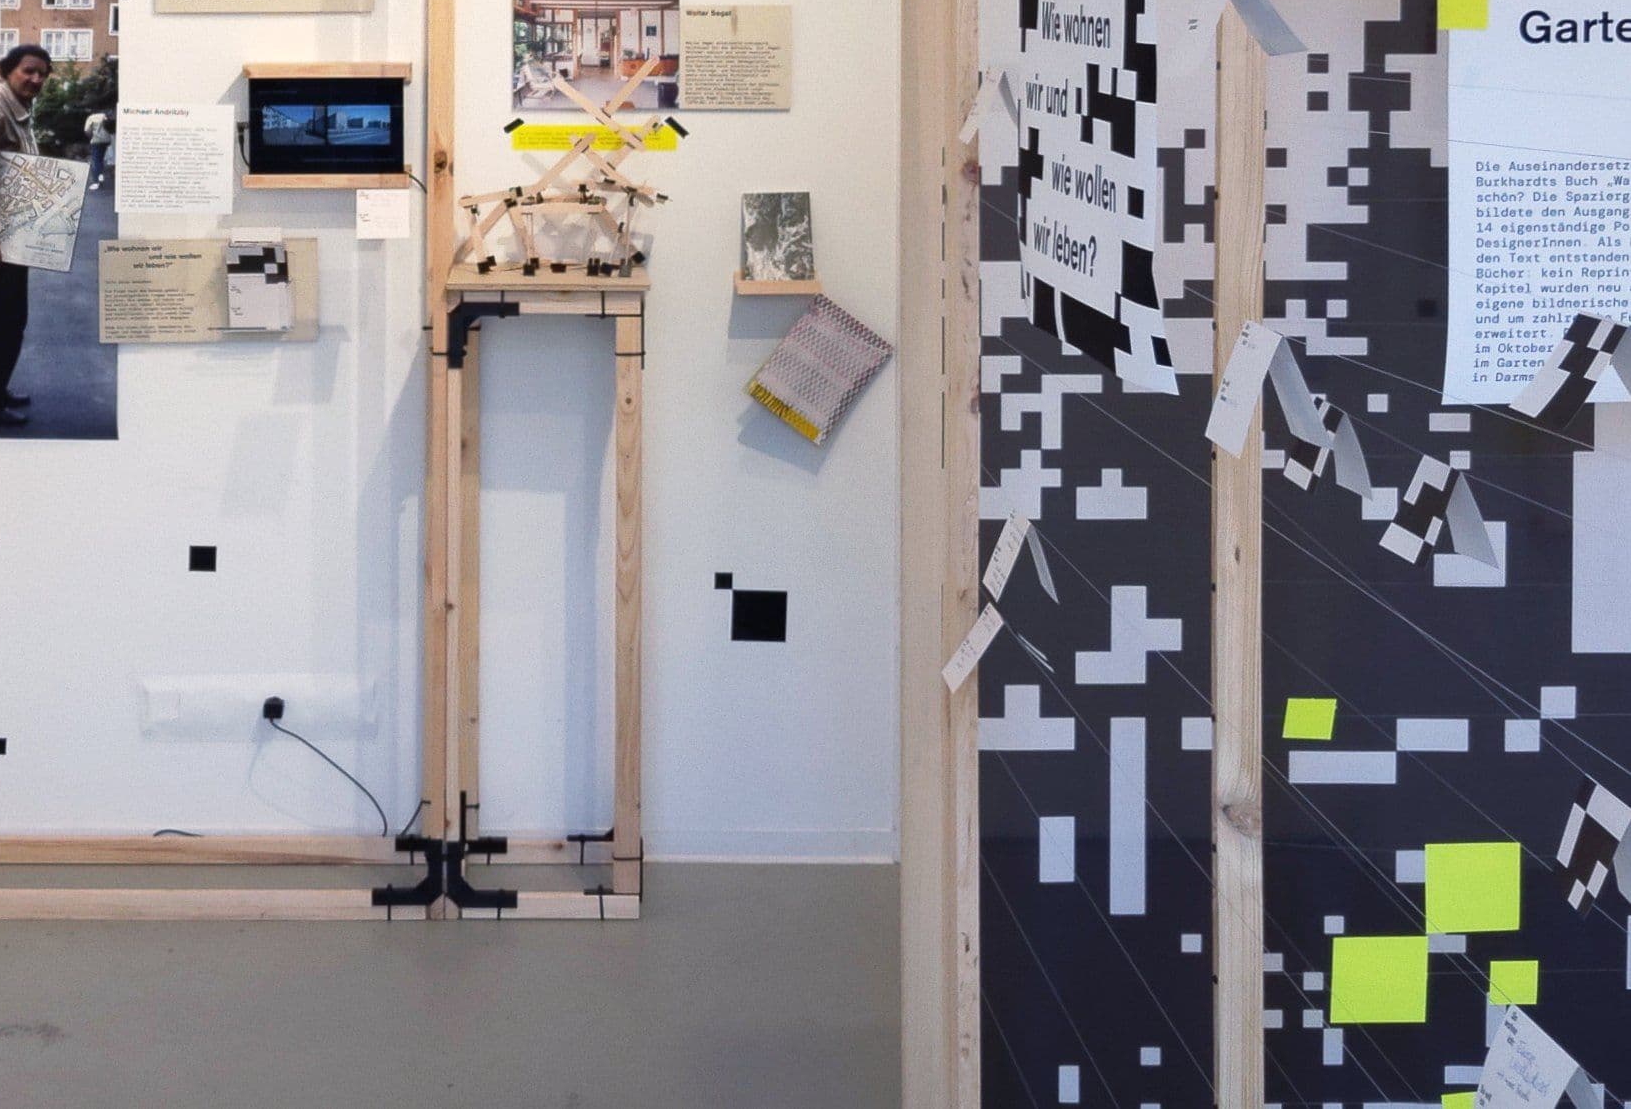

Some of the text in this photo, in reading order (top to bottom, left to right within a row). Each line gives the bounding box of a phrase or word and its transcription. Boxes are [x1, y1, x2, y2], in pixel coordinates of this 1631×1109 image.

[1042, 1, 1110, 49] Wie wohnen
[1026, 74, 1067, 117] wir und
[1476, 162, 1500, 172] Die
[1052, 154, 1116, 214] wie wollen
[1476, 176, 1557, 187] Burkhardts
[1565, 176, 1598, 187] Buch
[1477, 192, 1524, 203] schön?
[1533, 192, 1557, 202] Die
[1476, 207, 1533, 217] bildete
[1542, 207, 1565, 217] den
[1477, 223, 1492, 233] 14
[1501, 222, 1605, 235] eigenständige
[1034, 216, 1097, 277] wir leben?
[1598, 236, 1621, 247] Als
[1476, 252, 1629, 263] den Text entstanden
[1542, 268, 1573, 278] kein
[1476, 283, 1621, 295] Kapitel wurden neu
[1476, 298, 1629, 310] eigene bildnerische
[1476, 314, 1500, 324] und
[1508, 315, 1524, 324] um
[1475, 344, 1554, 353] im Oktober
[1474, 359, 1545, 368] im Garten
[1473, 374, 1487, 382] in
